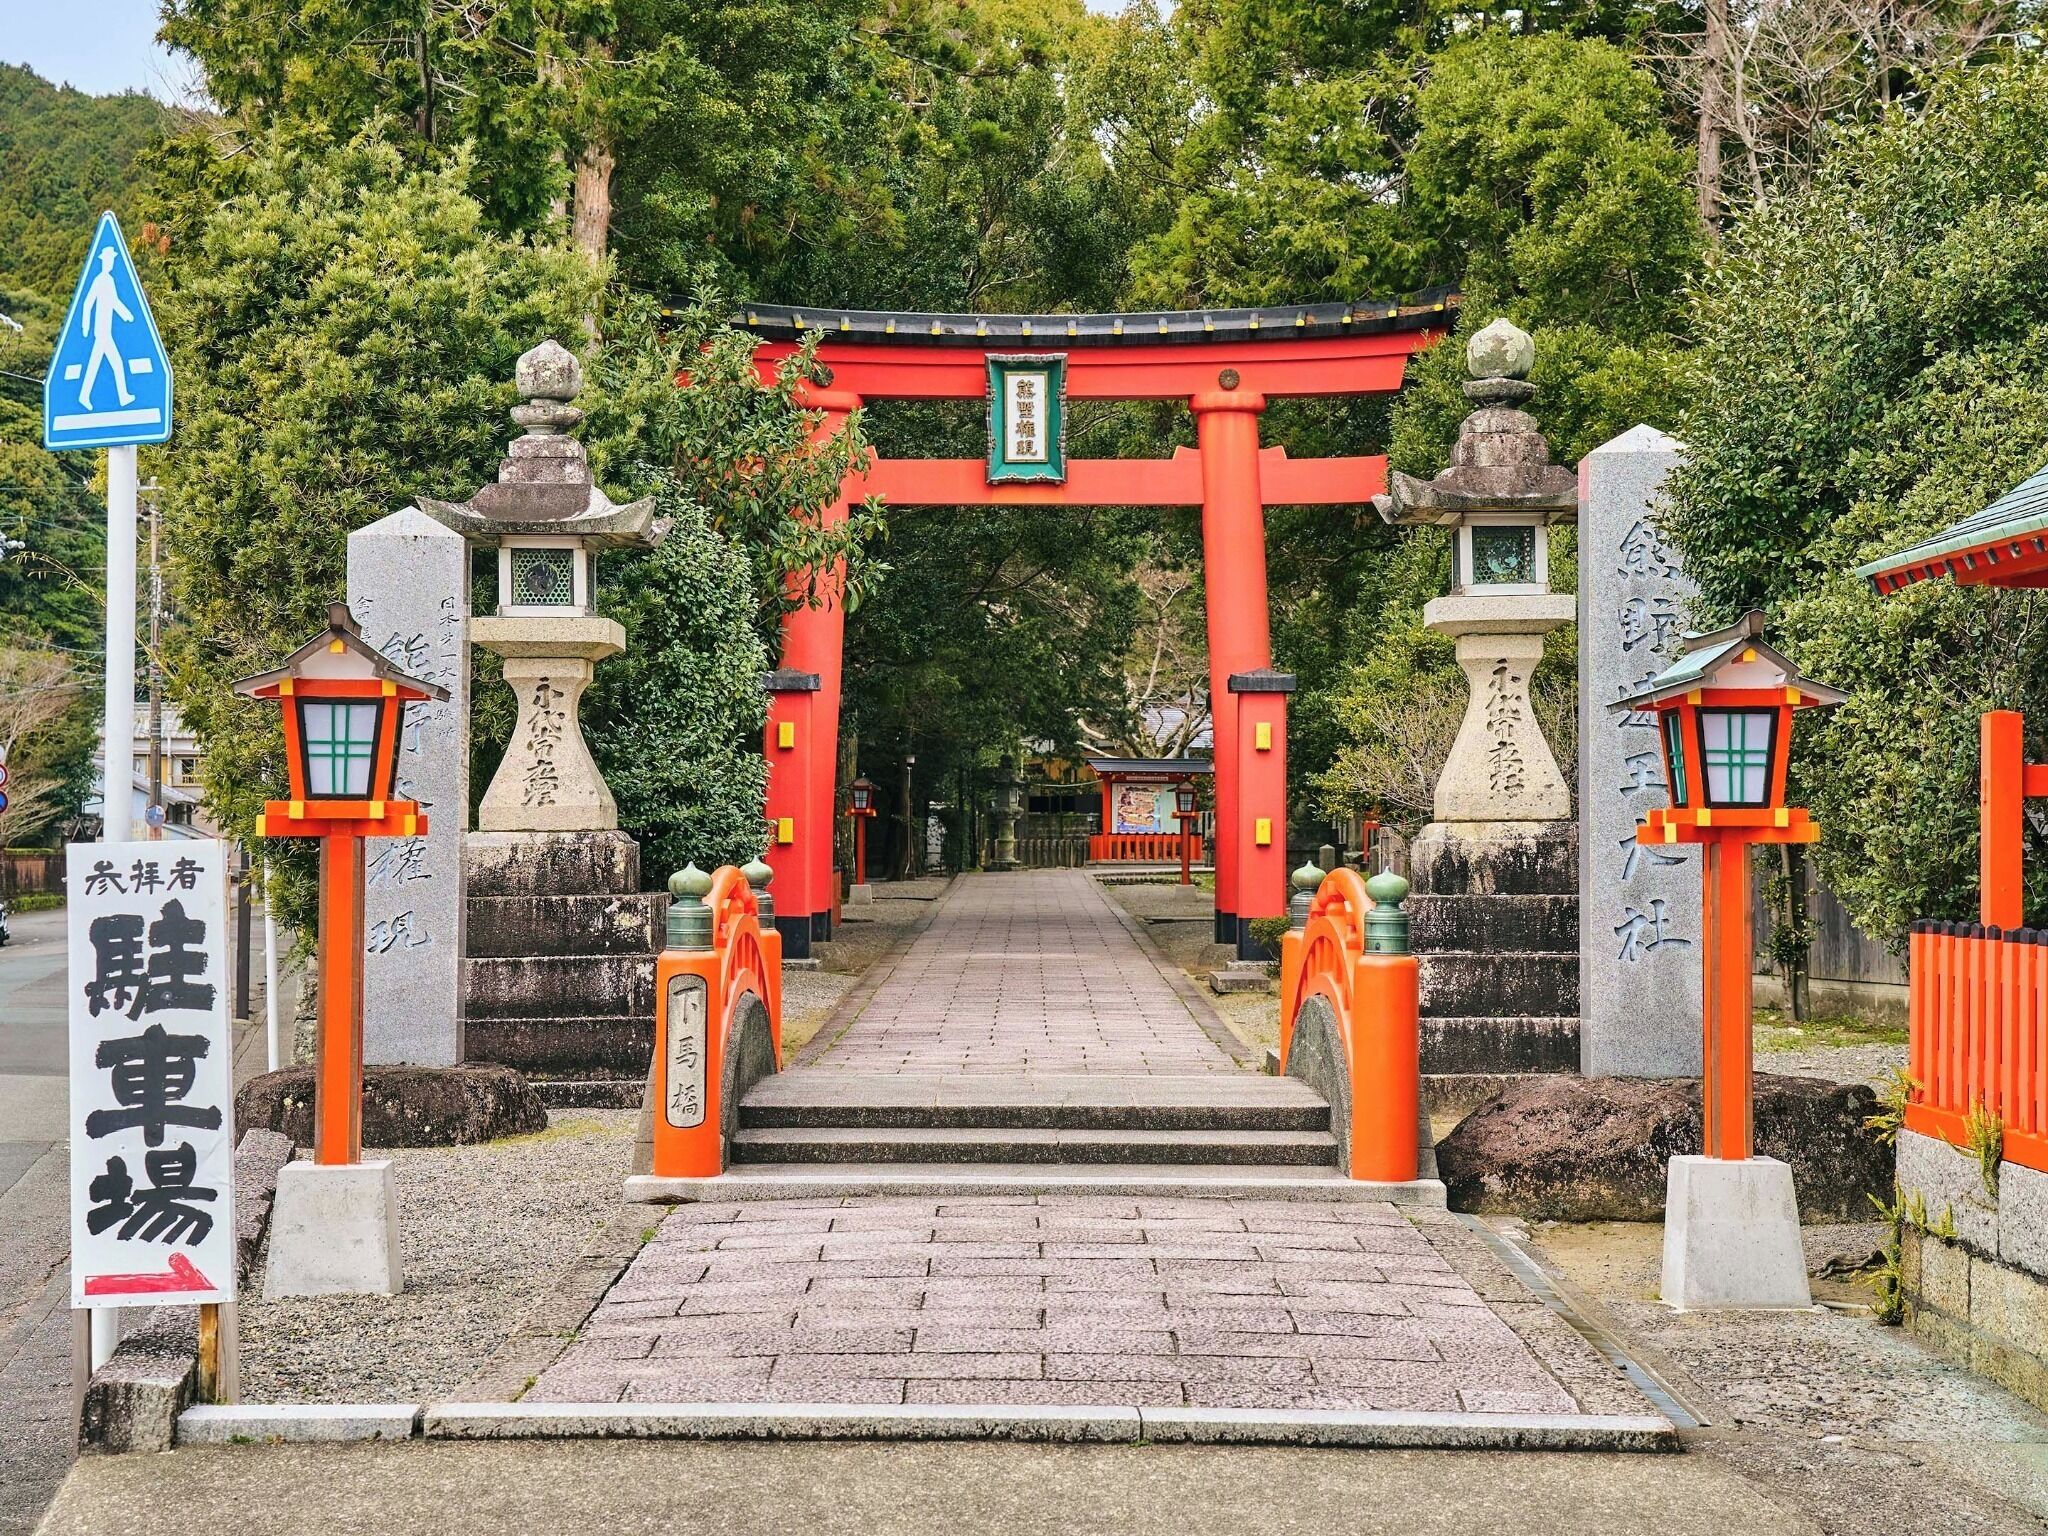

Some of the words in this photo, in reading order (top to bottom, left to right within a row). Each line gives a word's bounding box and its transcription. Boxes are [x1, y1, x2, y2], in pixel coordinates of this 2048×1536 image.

[85, 857, 204, 896] 参拝者
[85, 899, 222, 1247] 駐車場
[672, 986, 704, 1116] 下馬橋
